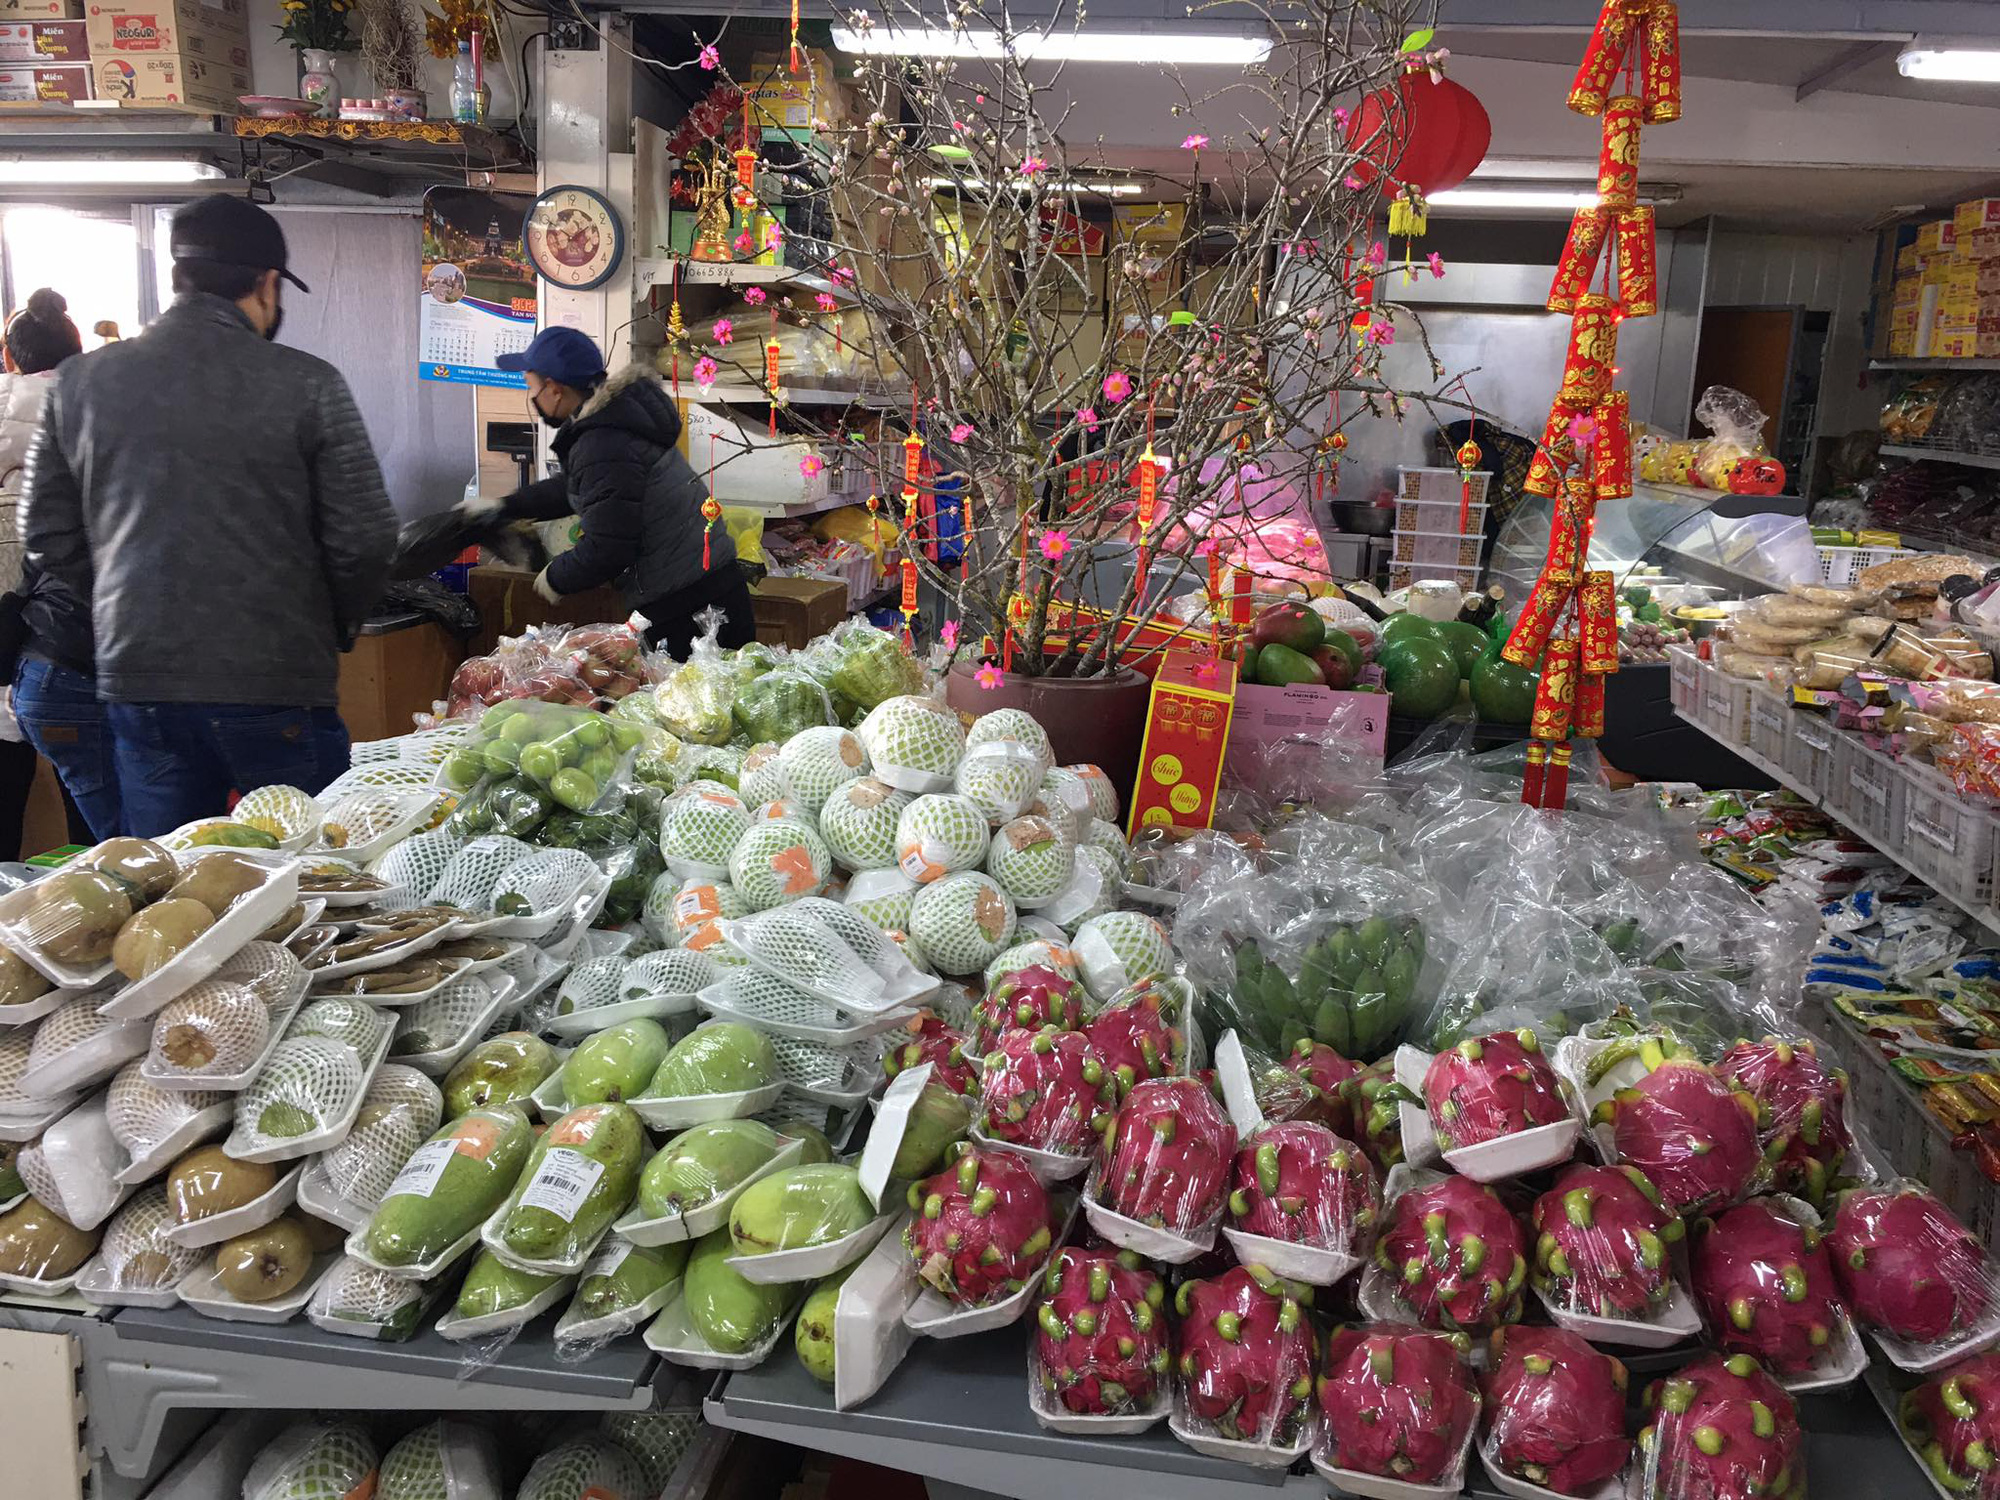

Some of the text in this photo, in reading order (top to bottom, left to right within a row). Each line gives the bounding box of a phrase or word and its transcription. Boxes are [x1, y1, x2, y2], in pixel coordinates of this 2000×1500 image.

[116, 27, 155, 38] NEOGURI
[566, 194, 577, 208] 12
[587, 199, 592, 210] 1
[599, 212, 607, 225] 2
[605, 232, 613, 246] 3
[540, 251, 549, 263] 8
[600, 252, 608, 264] 4
[555, 264, 562, 276] 7
[571, 270, 580, 282] 6
[588, 265, 596, 277] 5
[1283, 692, 1320, 700] FLAMINGO
